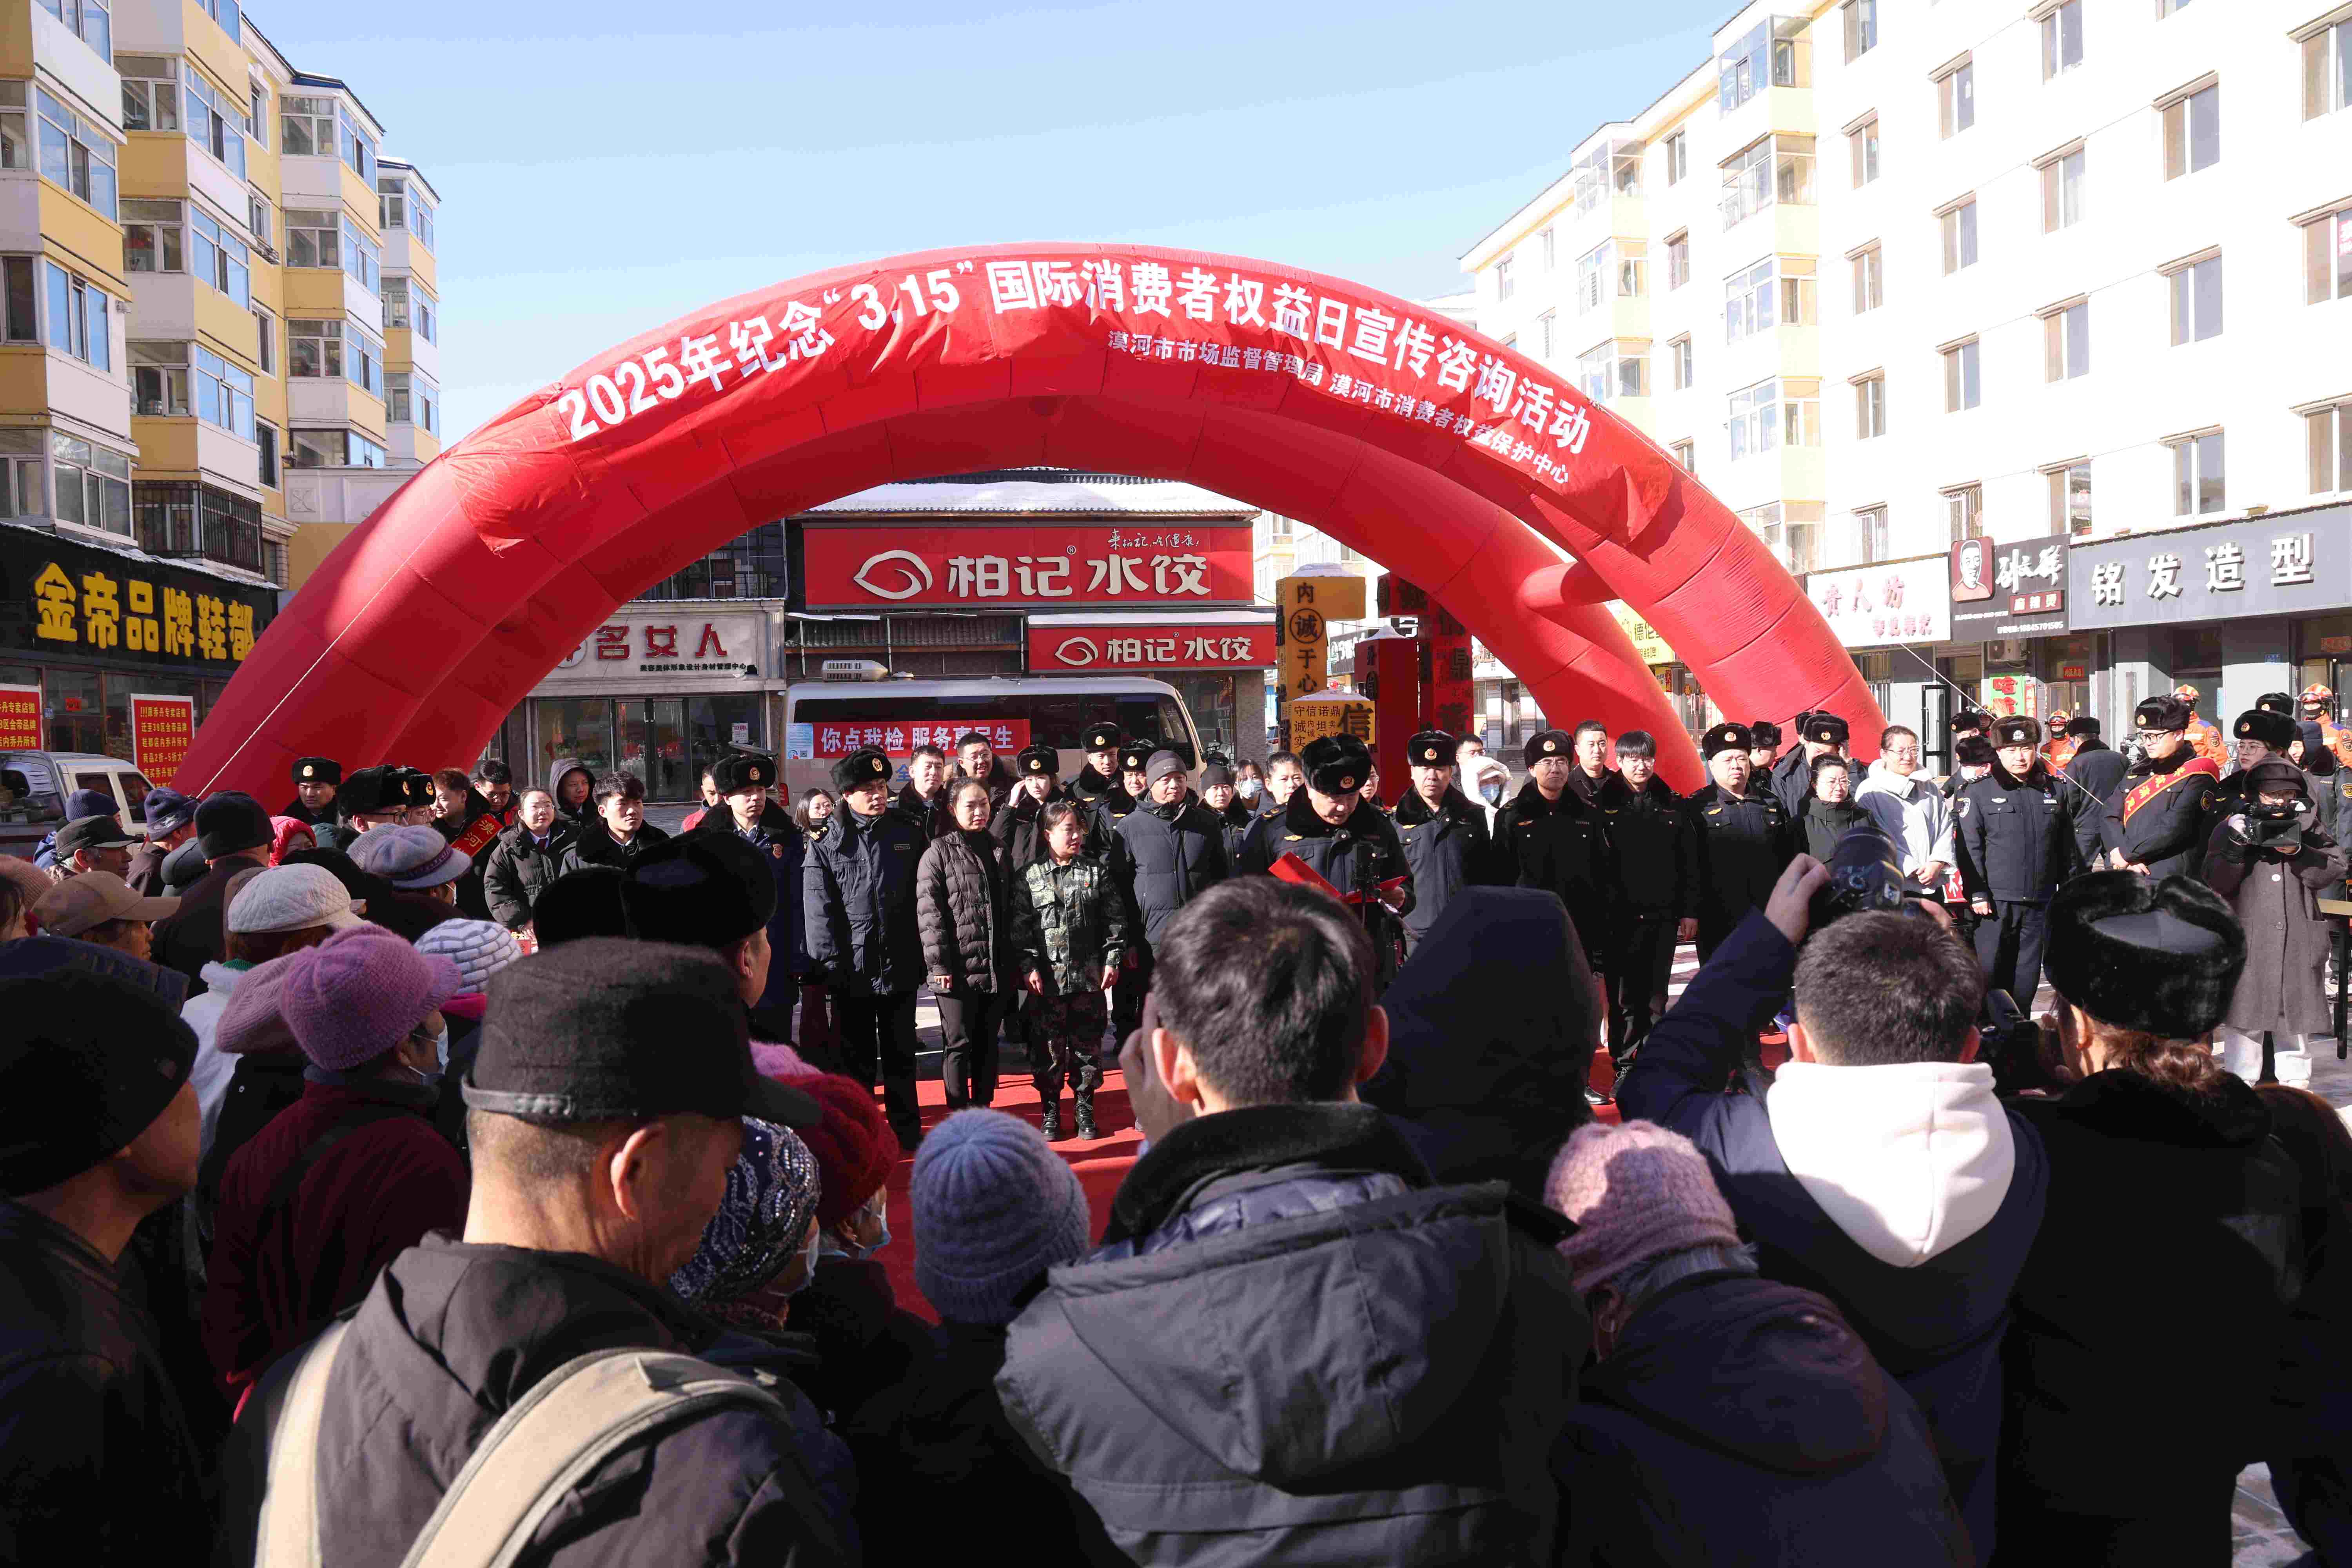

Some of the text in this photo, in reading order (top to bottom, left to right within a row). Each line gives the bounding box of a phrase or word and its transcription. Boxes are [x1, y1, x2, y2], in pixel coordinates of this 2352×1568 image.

[2091, 533, 2314, 606] 铭发造型
[34, 562, 254, 661] 金帝品牌鞋都
[596, 624, 728, 661] 名女人
